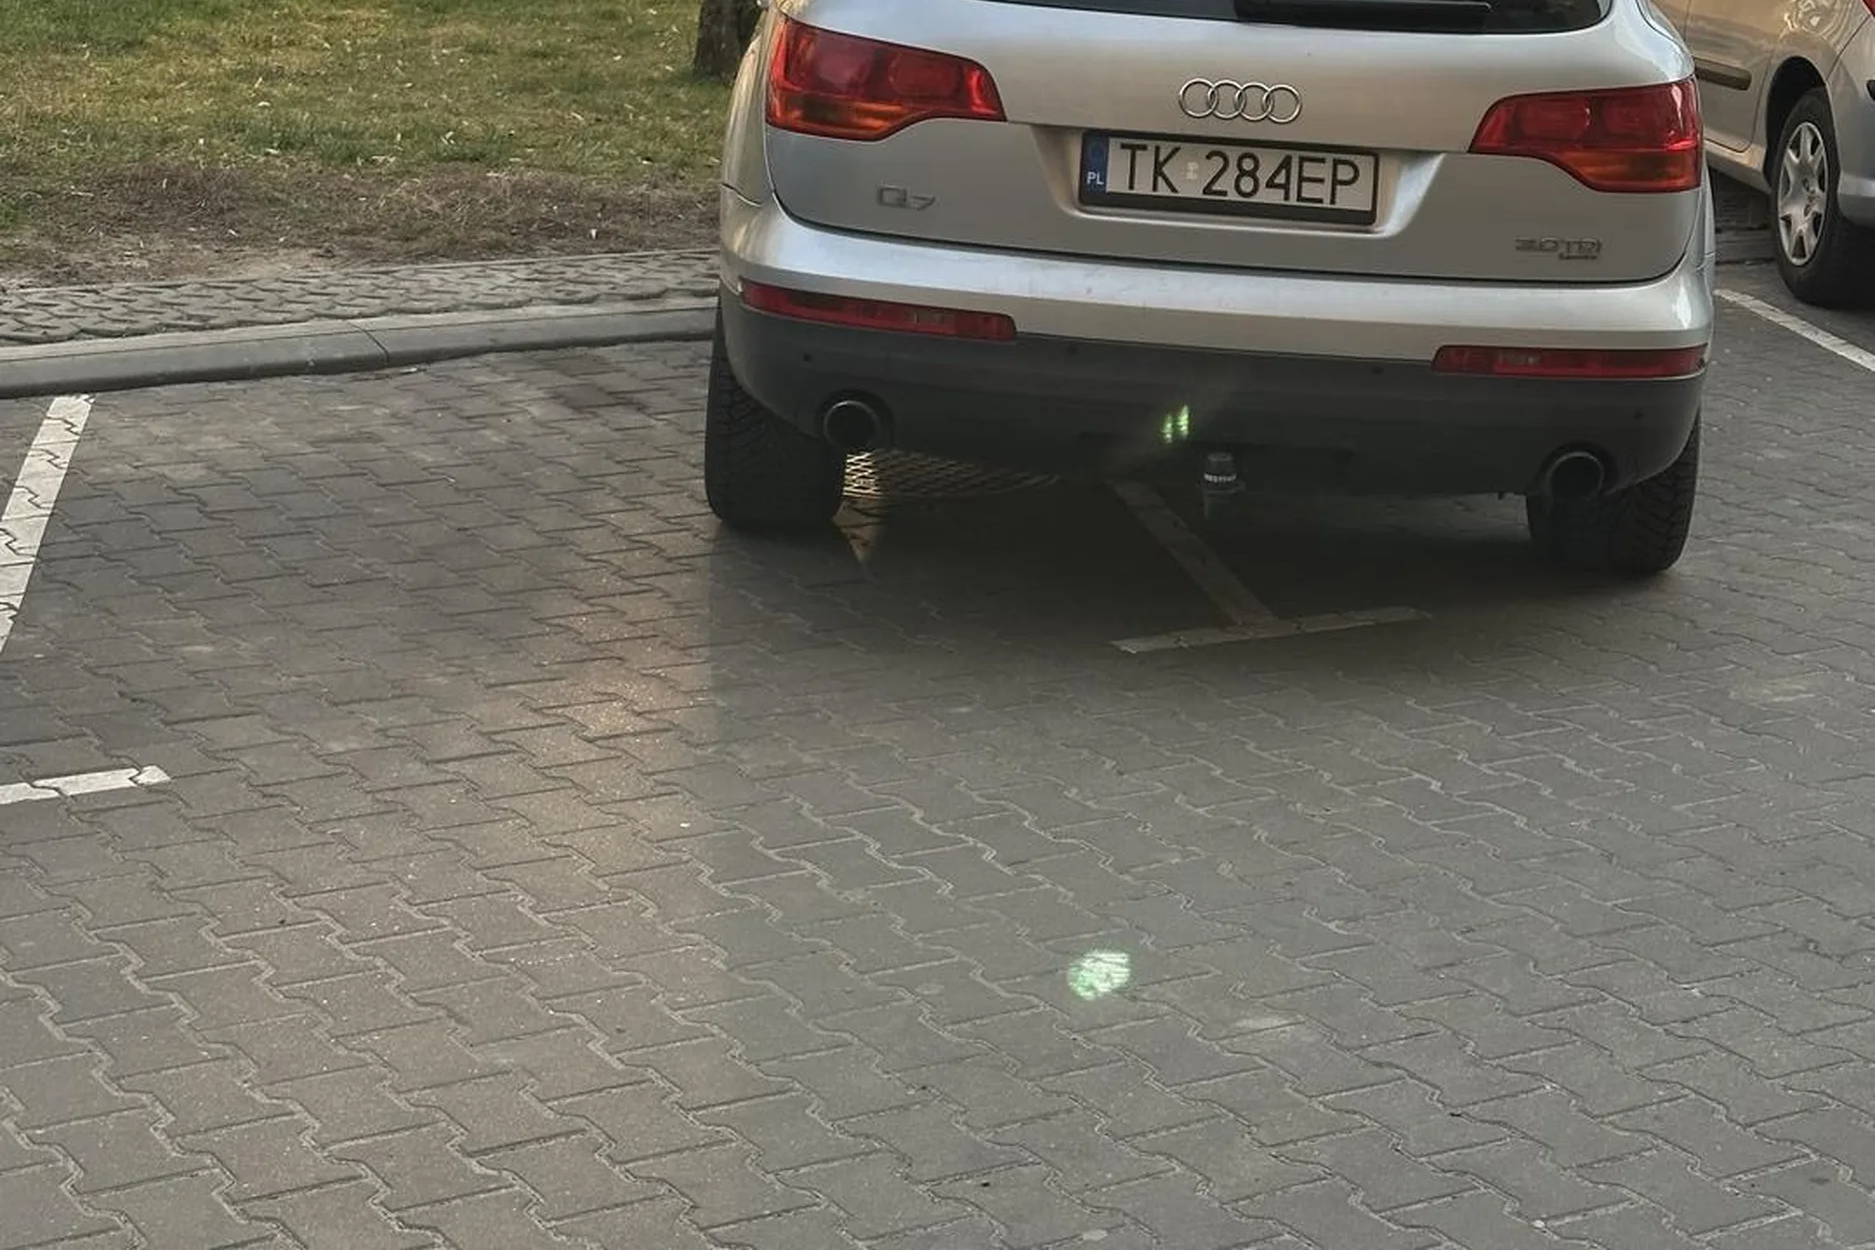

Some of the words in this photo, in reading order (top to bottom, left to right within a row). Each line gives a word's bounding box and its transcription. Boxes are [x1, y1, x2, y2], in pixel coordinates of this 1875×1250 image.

[1086, 171, 1104, 185] PL
[1120, 143, 1182, 194] TK
[1202, 150, 1361, 206] 284EP
